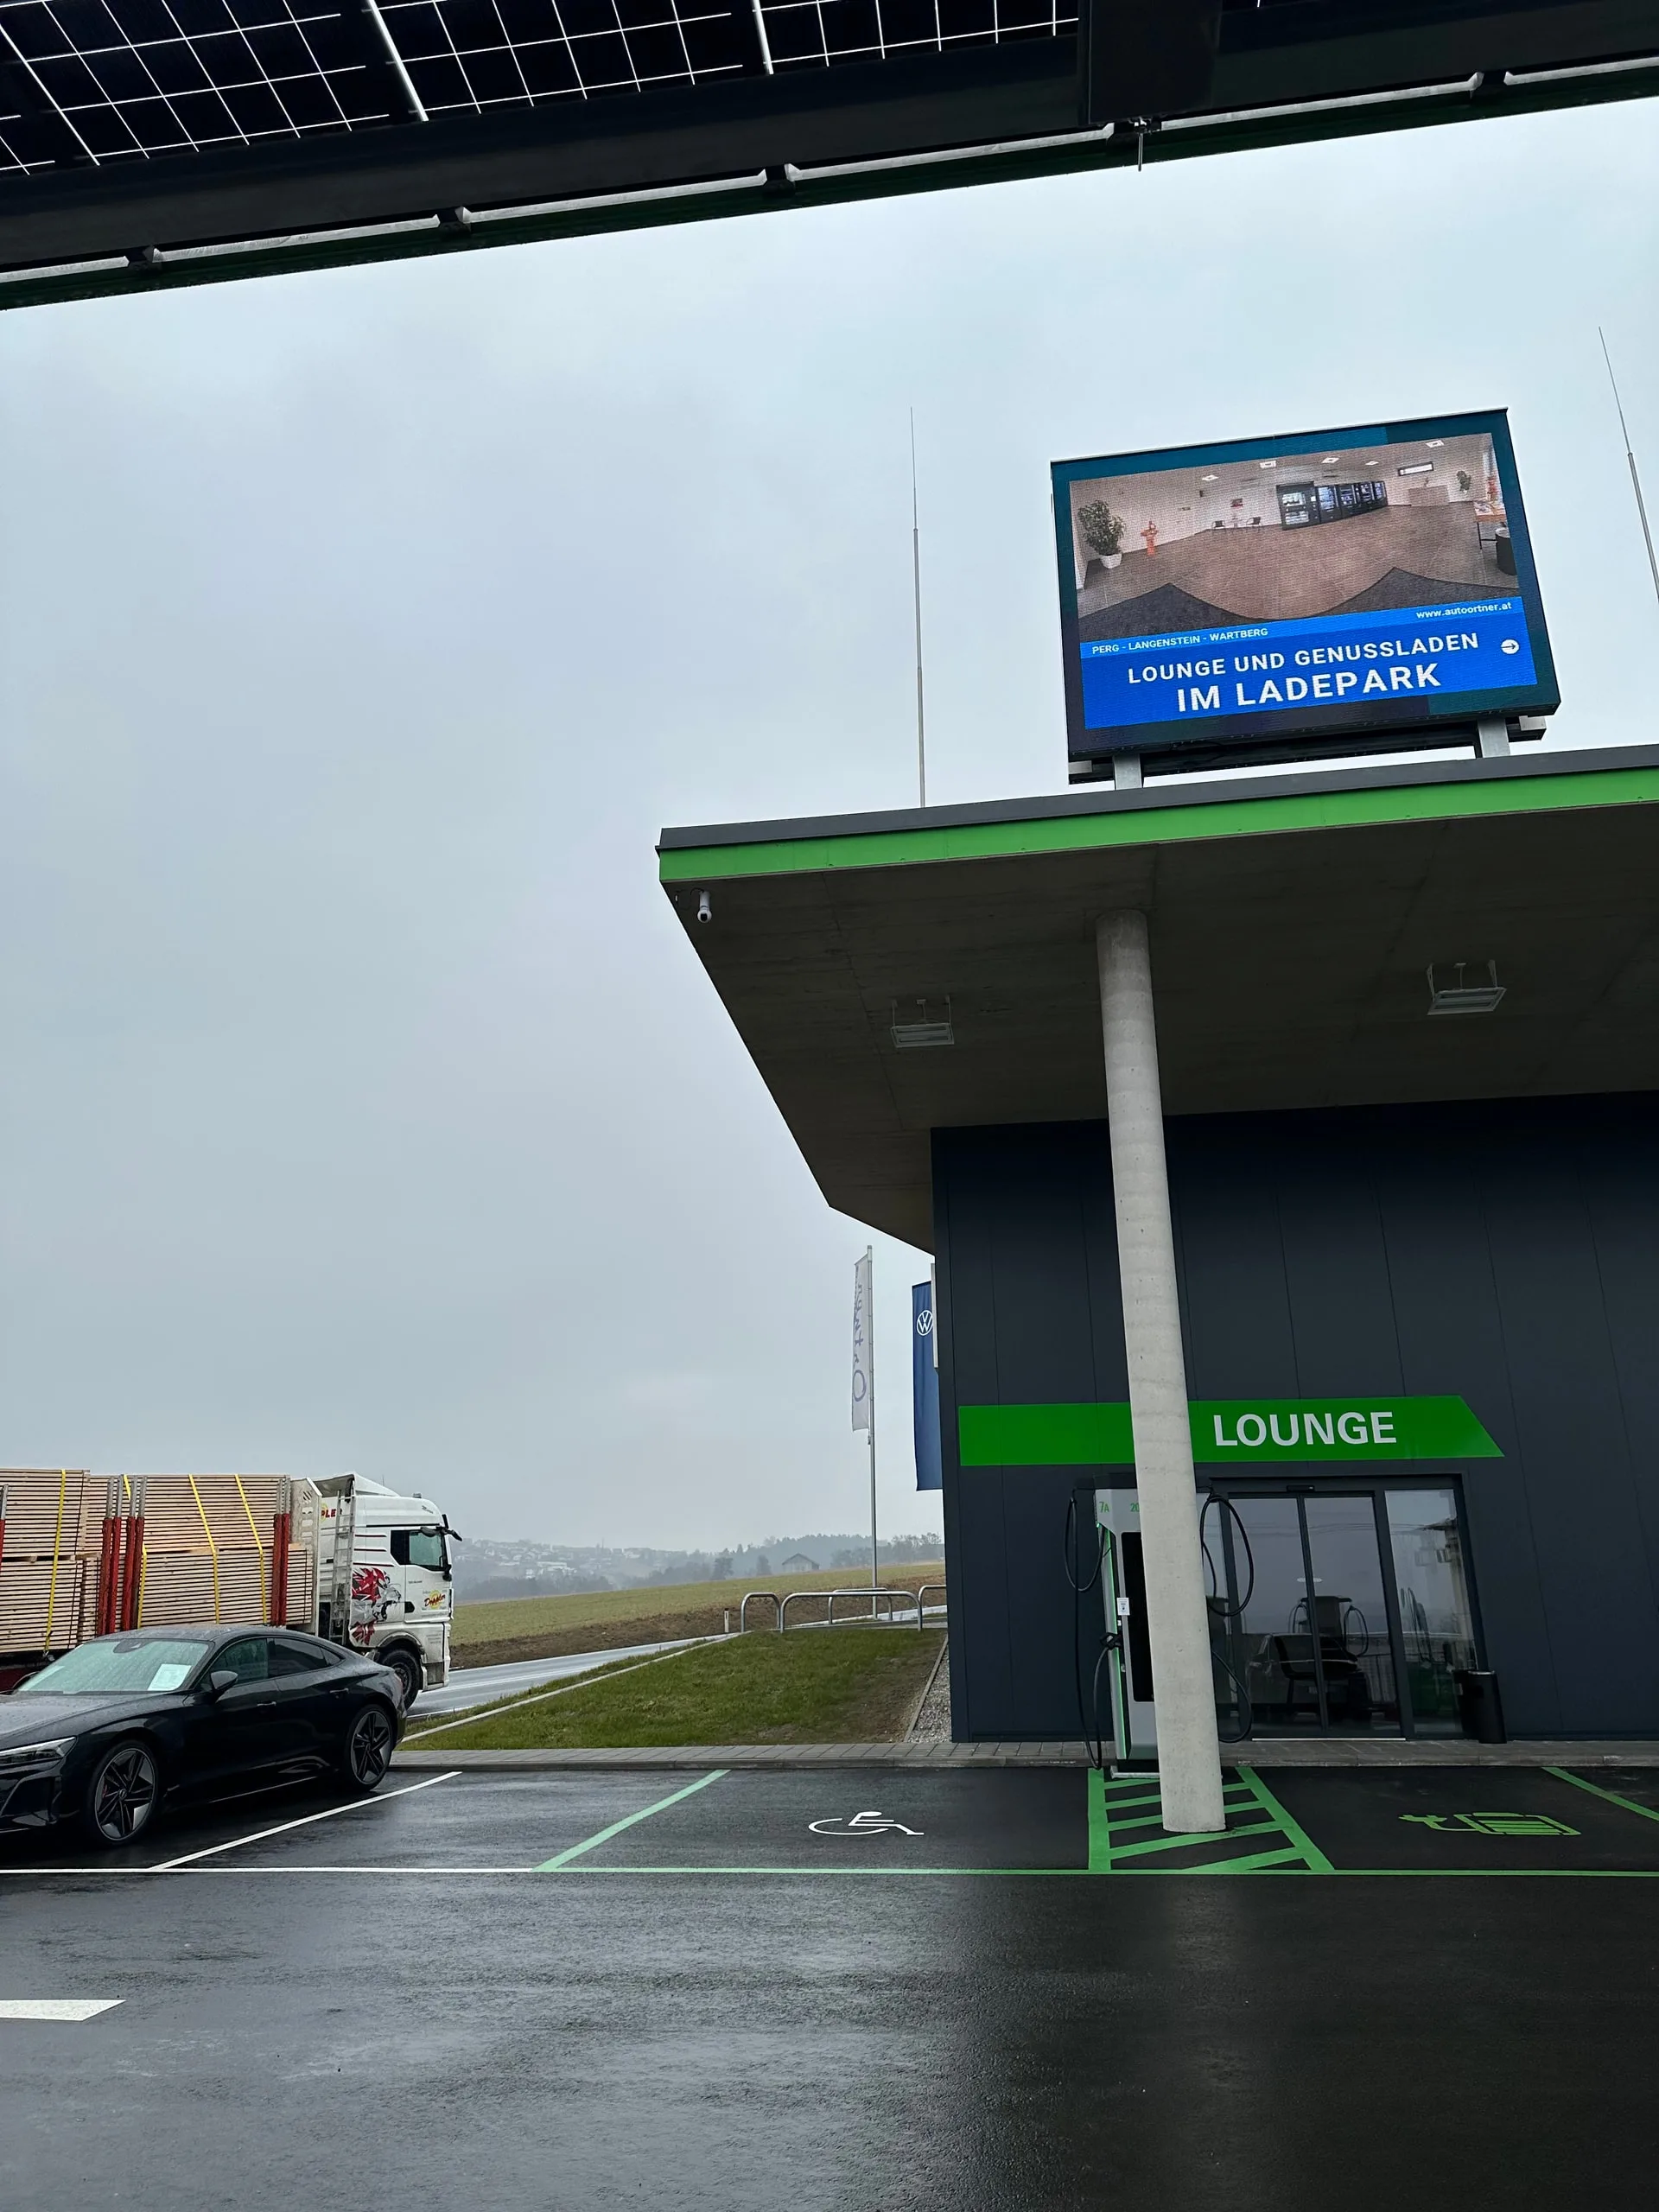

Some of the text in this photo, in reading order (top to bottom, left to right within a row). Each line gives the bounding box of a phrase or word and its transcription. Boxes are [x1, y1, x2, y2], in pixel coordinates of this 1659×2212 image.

[1416, 601, 1513, 619] www.autoortner.at
[1092, 644, 1120, 654] PERG
[1128, 634, 1200, 651] LANGENSTEIN
[1210, 627, 1268, 642] WARTBERG
[1128, 632, 1479, 684] LOUNGE UND GENUSSLADEN
[1177, 662, 1442, 712] IM LADEPARK
[1213, 1411, 1397, 1447] LOUNGE
